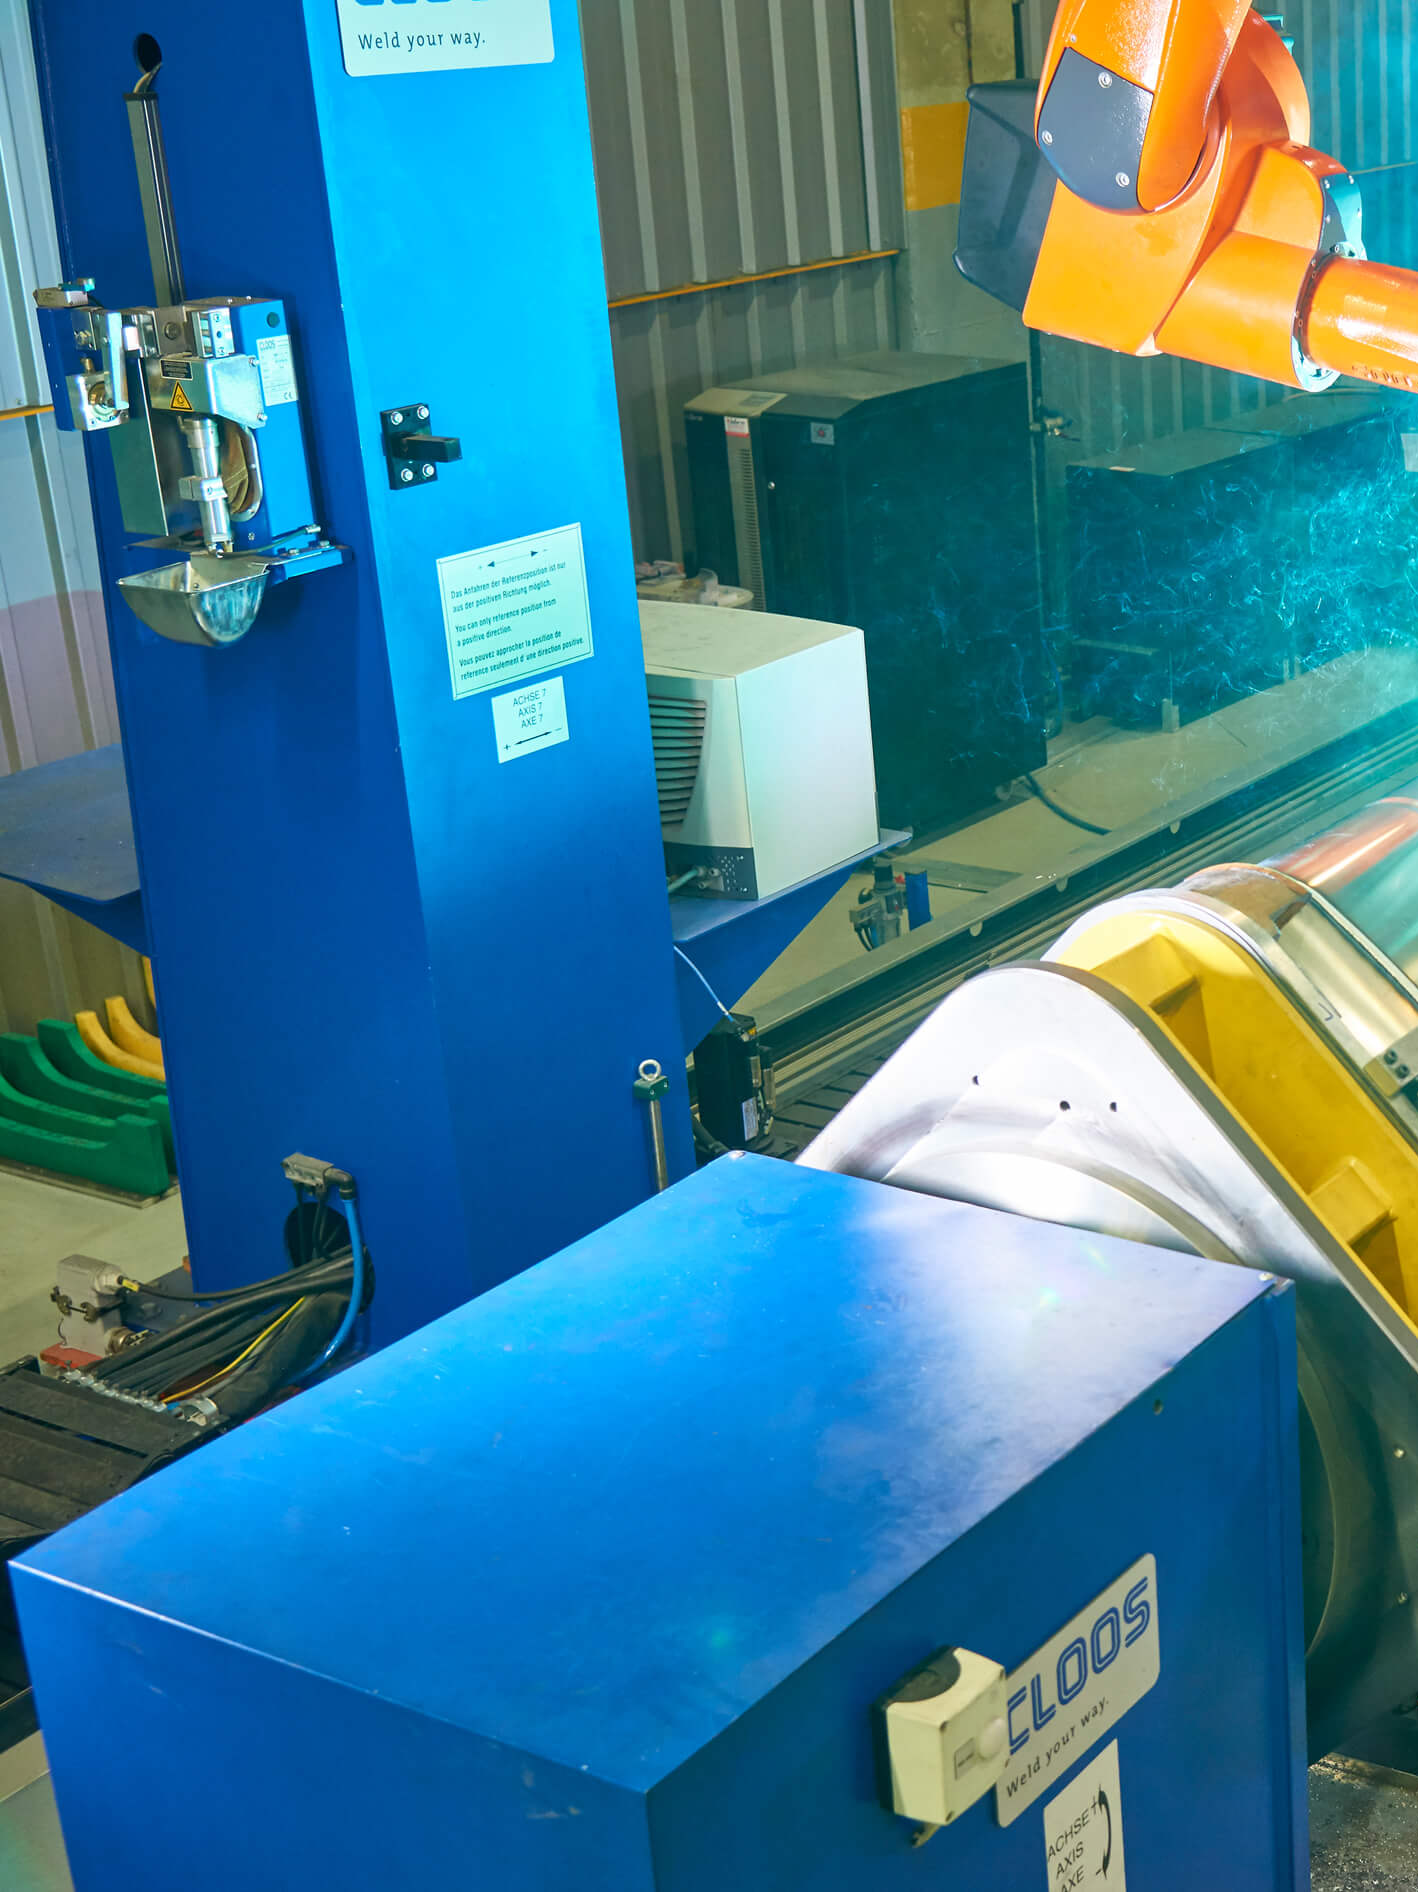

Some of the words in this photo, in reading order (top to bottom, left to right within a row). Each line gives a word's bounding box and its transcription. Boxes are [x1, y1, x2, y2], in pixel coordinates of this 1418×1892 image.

[358, 31, 401, 50] Weld
[407, 33, 444, 52] your
[450, 31, 486, 49] way.
[450, 589, 463, 600] Das
[491, 580, 500, 589] der
[502, 567, 547, 585] Referenzposition
[452, 604, 464, 613] aus
[465, 601, 474, 610] der
[476, 593, 502, 608] positiven
[503, 586, 528, 600] Richtung
[455, 624, 467, 633] You
[468, 620, 478, 630] can
[480, 615, 491, 627] only
[493, 608, 519, 621] reference
[521, 602, 542, 615] position
[544, 598, 557, 608] from
[459, 657, 473, 668] Vous
[475, 650, 495, 665] pouvez
[496, 641, 524, 657] approcher
[525, 639, 531, 648] la
[532, 632, 553, 647] position
[554, 629, 562, 639] de
[462, 633, 485, 648] positive
[490, 655, 519, 672] seulement
[527, 651, 537, 661] une
[538, 643, 562, 658] direction
[513, 691, 540, 707] ACHSE
[541, 688, 546, 697] 7
[519, 704, 536, 717] AXIS
[538, 702, 543, 710] 7
[522, 716, 537, 728] AXE
[538, 714, 543, 722] 7
[1007, 1576, 1151, 1756] CLOOS
[1006, 1757, 1041, 1798] Weld
[1046, 1728, 1077, 1767] your
[1081, 1697, 1110, 1728] way.
[1047, 1808, 1090, 1862] ACHSE
[1056, 1841, 1084, 1880] AXIS
[1060, 1865, 1085, 1892] AXE
